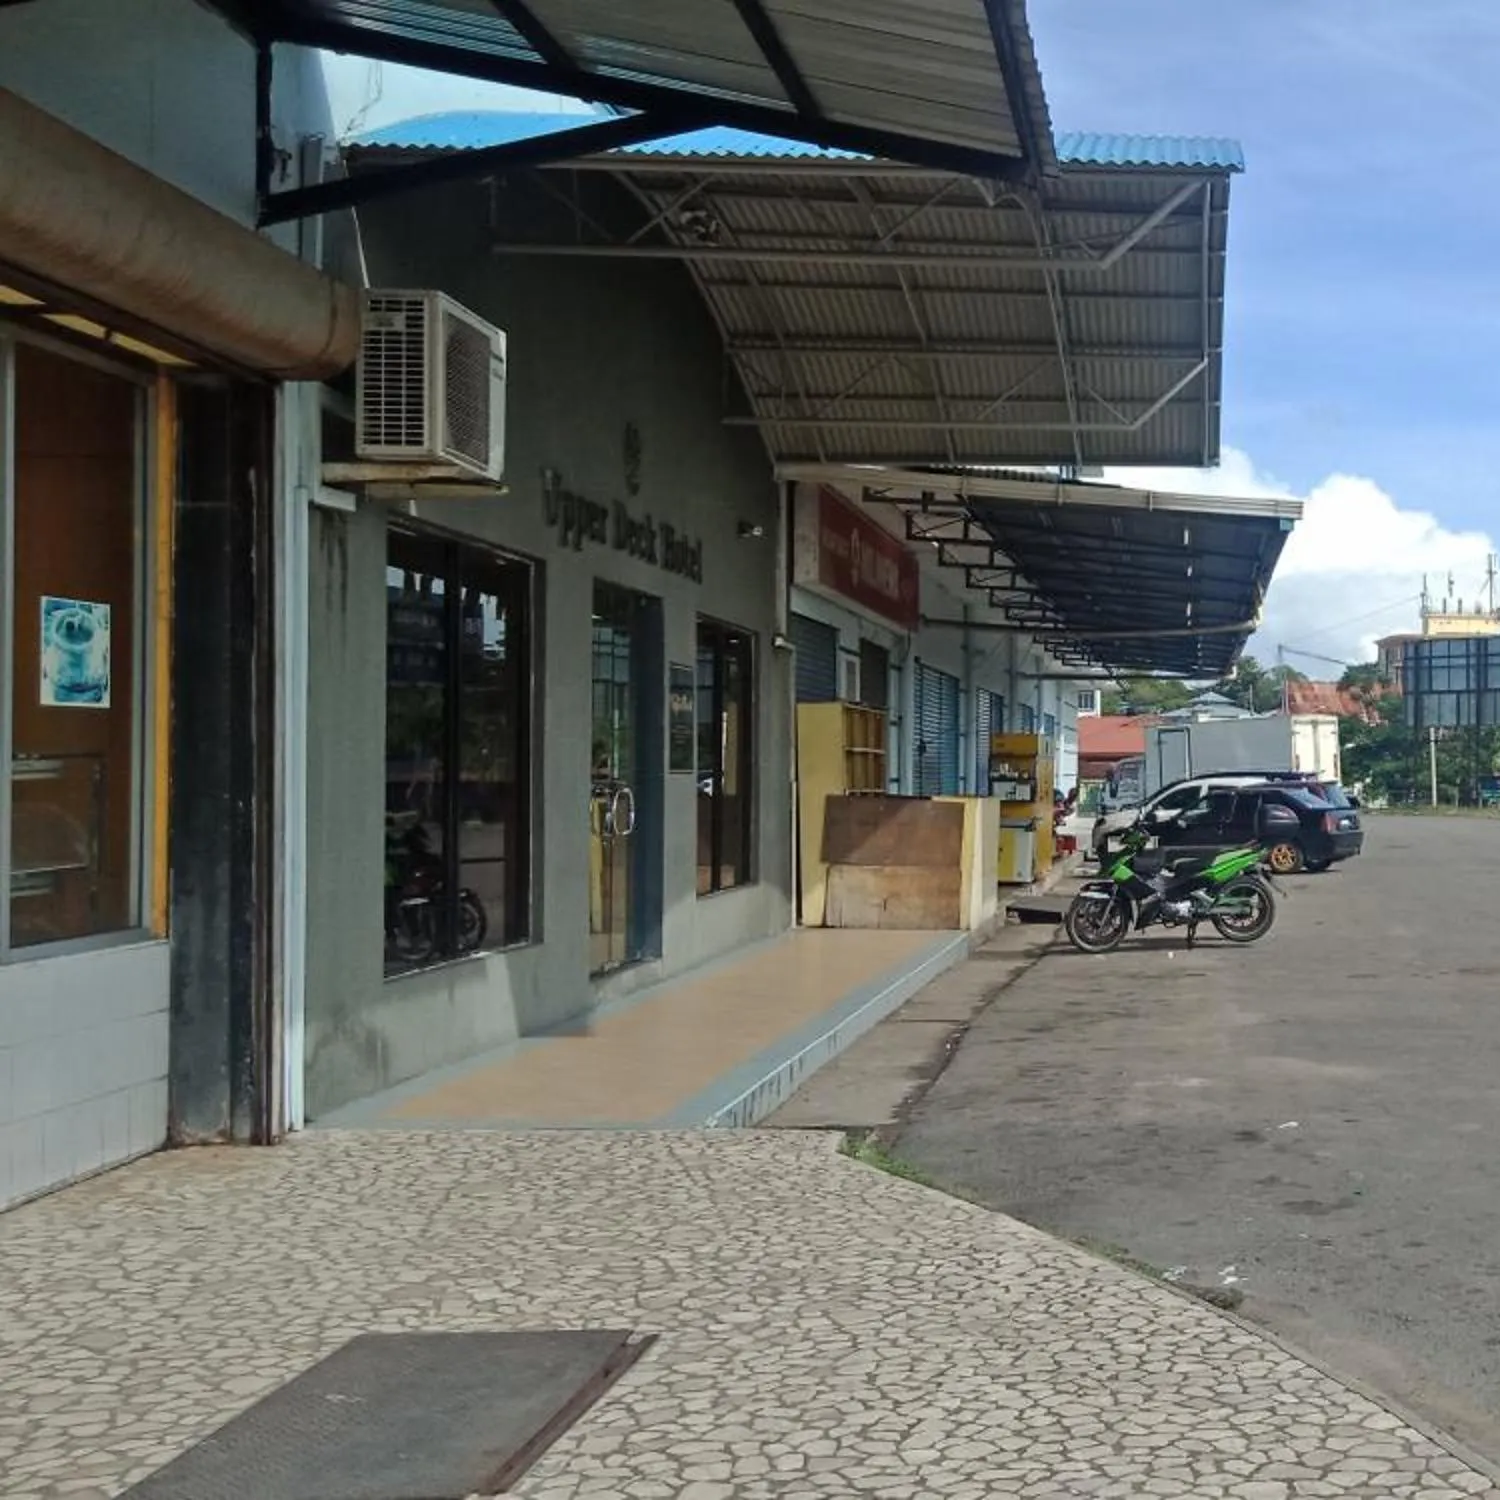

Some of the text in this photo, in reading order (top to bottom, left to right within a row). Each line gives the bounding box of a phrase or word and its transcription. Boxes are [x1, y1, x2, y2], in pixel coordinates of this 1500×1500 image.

[541, 466, 703, 584] Upper Deck Hotel
